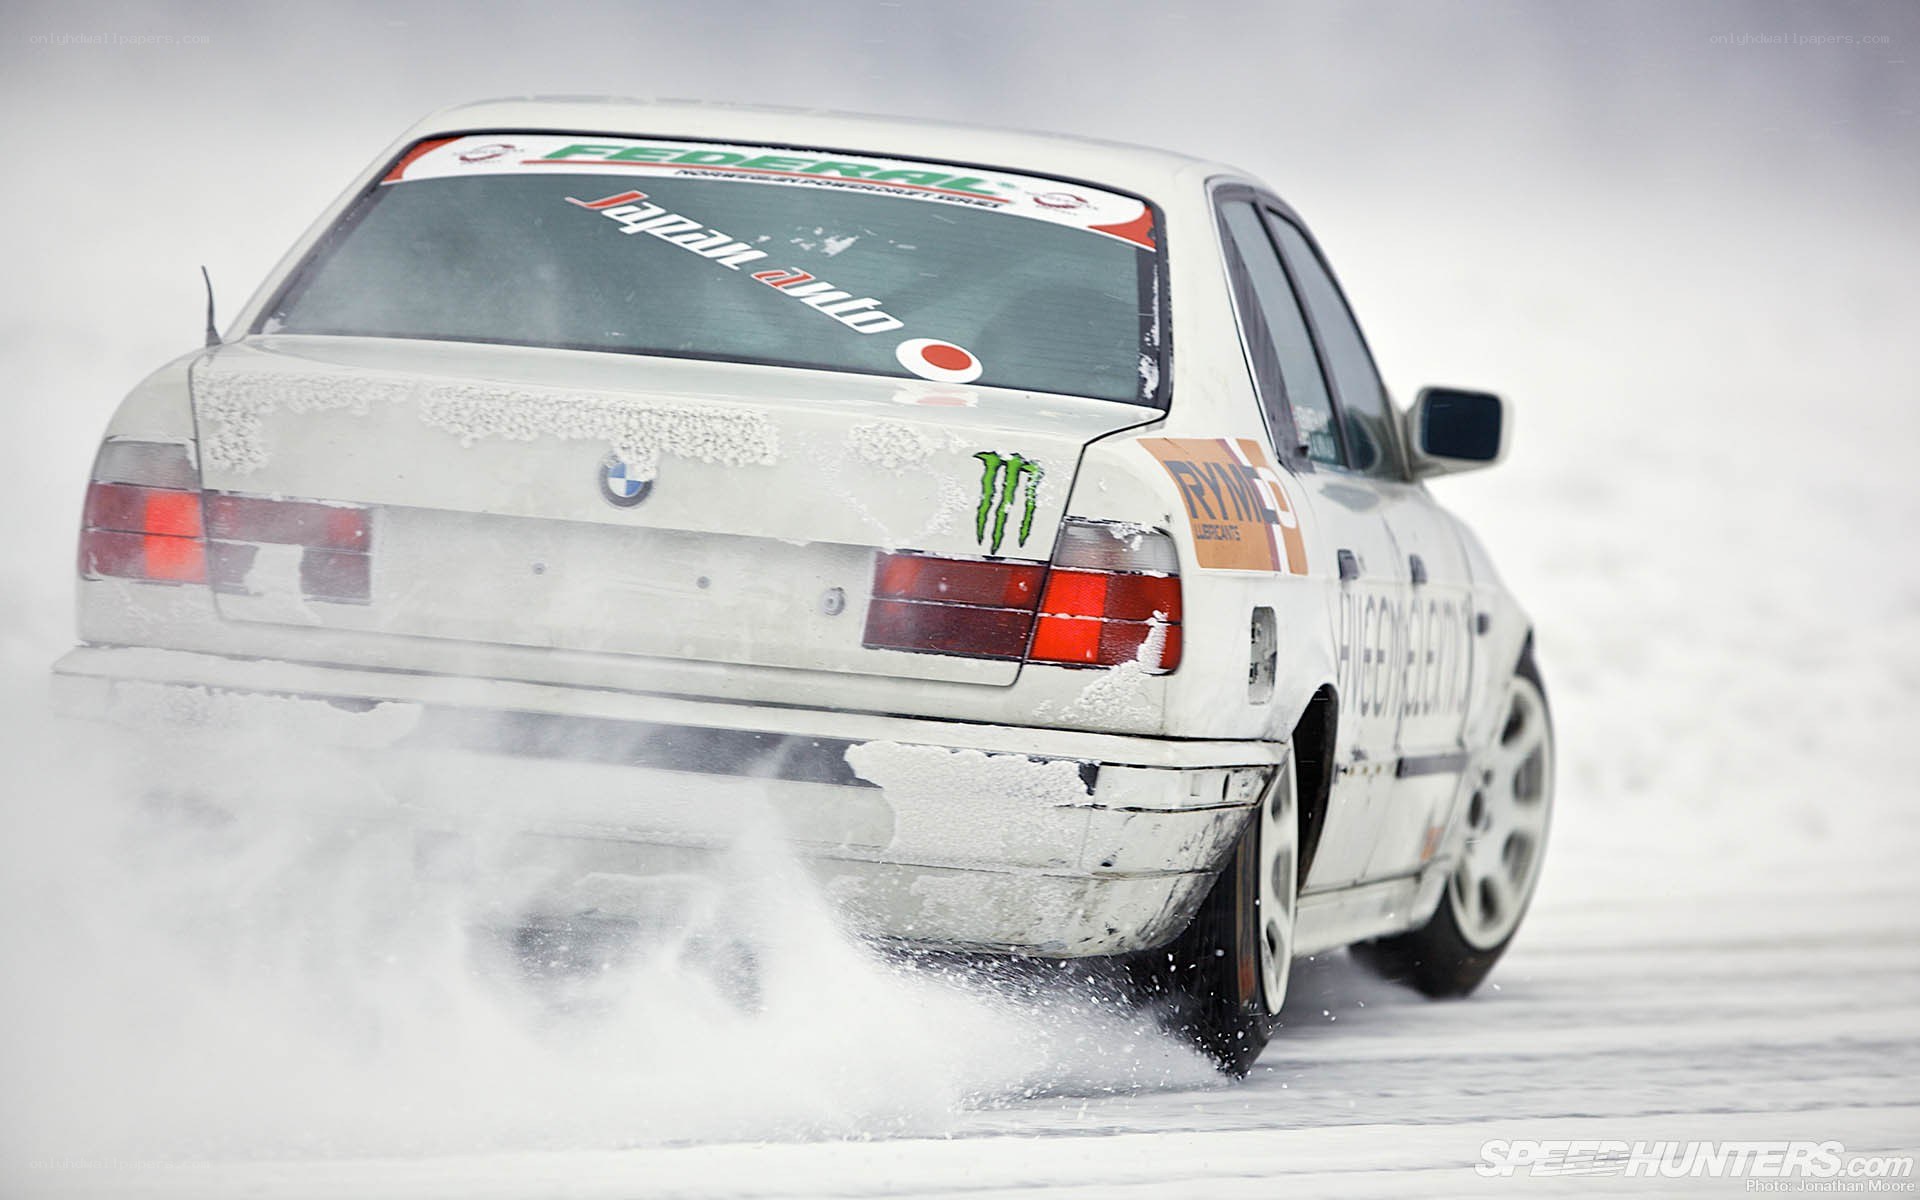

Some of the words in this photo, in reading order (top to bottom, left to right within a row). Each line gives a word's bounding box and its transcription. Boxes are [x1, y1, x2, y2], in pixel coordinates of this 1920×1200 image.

[542, 143, 1000, 195] FEDERAL
[565, 189, 769, 271] Japan
[751, 266, 905, 335] auto
